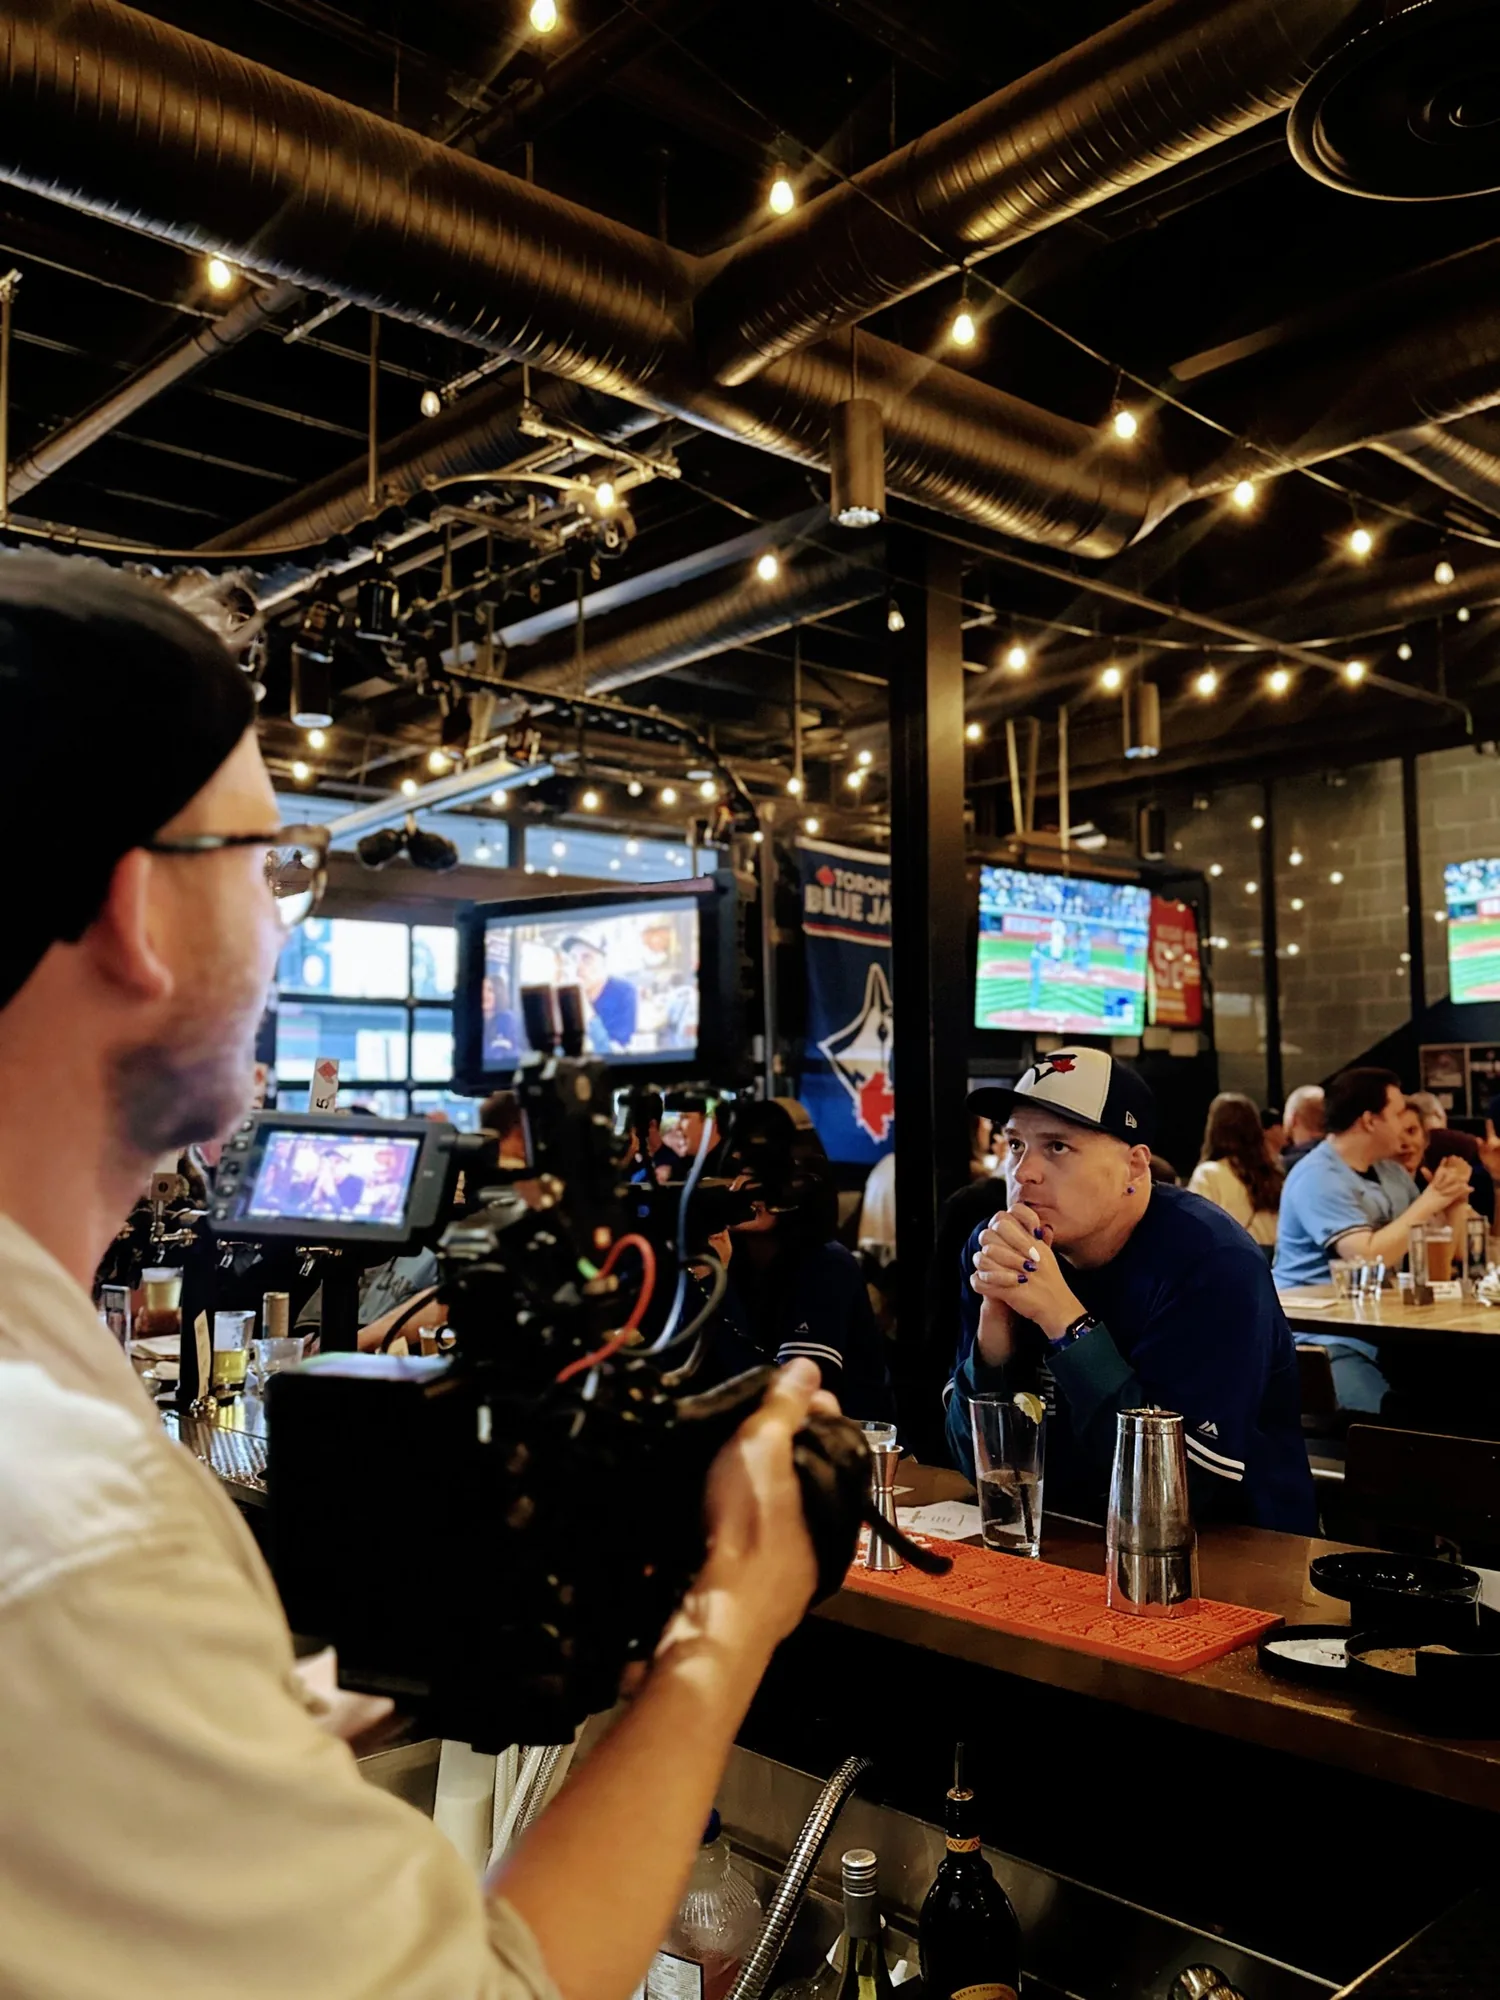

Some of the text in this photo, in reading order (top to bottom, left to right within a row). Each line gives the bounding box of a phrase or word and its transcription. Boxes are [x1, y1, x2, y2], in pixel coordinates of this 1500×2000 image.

[833, 868, 891, 895] TORON
[804, 884, 891, 924] BLUE JA
